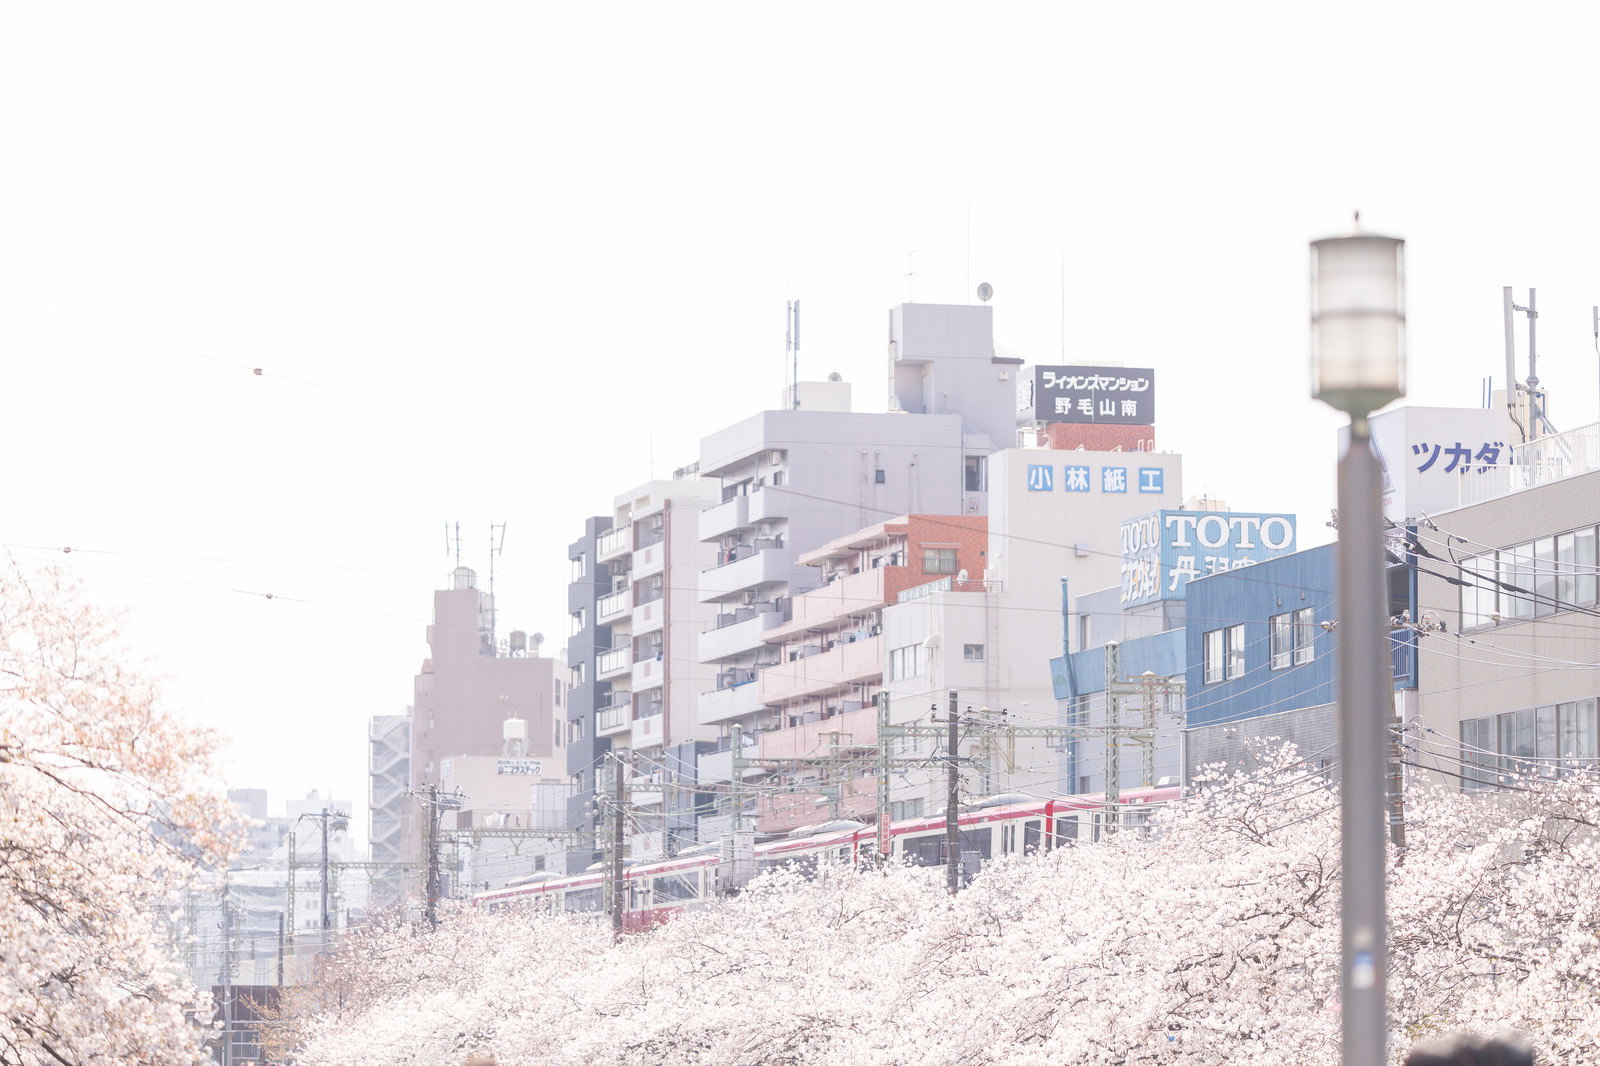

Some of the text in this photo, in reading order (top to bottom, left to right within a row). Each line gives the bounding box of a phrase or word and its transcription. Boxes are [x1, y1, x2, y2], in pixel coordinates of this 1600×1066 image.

[1042, 371, 1149, 392] ライオンズマンション
[1055, 397, 1137, 417] 野毛山南
[1411, 441, 1505, 475] ツカダ
[1029, 466, 1162, 492] 小林紙工
[1121, 516, 1160, 555] TOTO
[1165, 515, 1293, 549] TOTO
